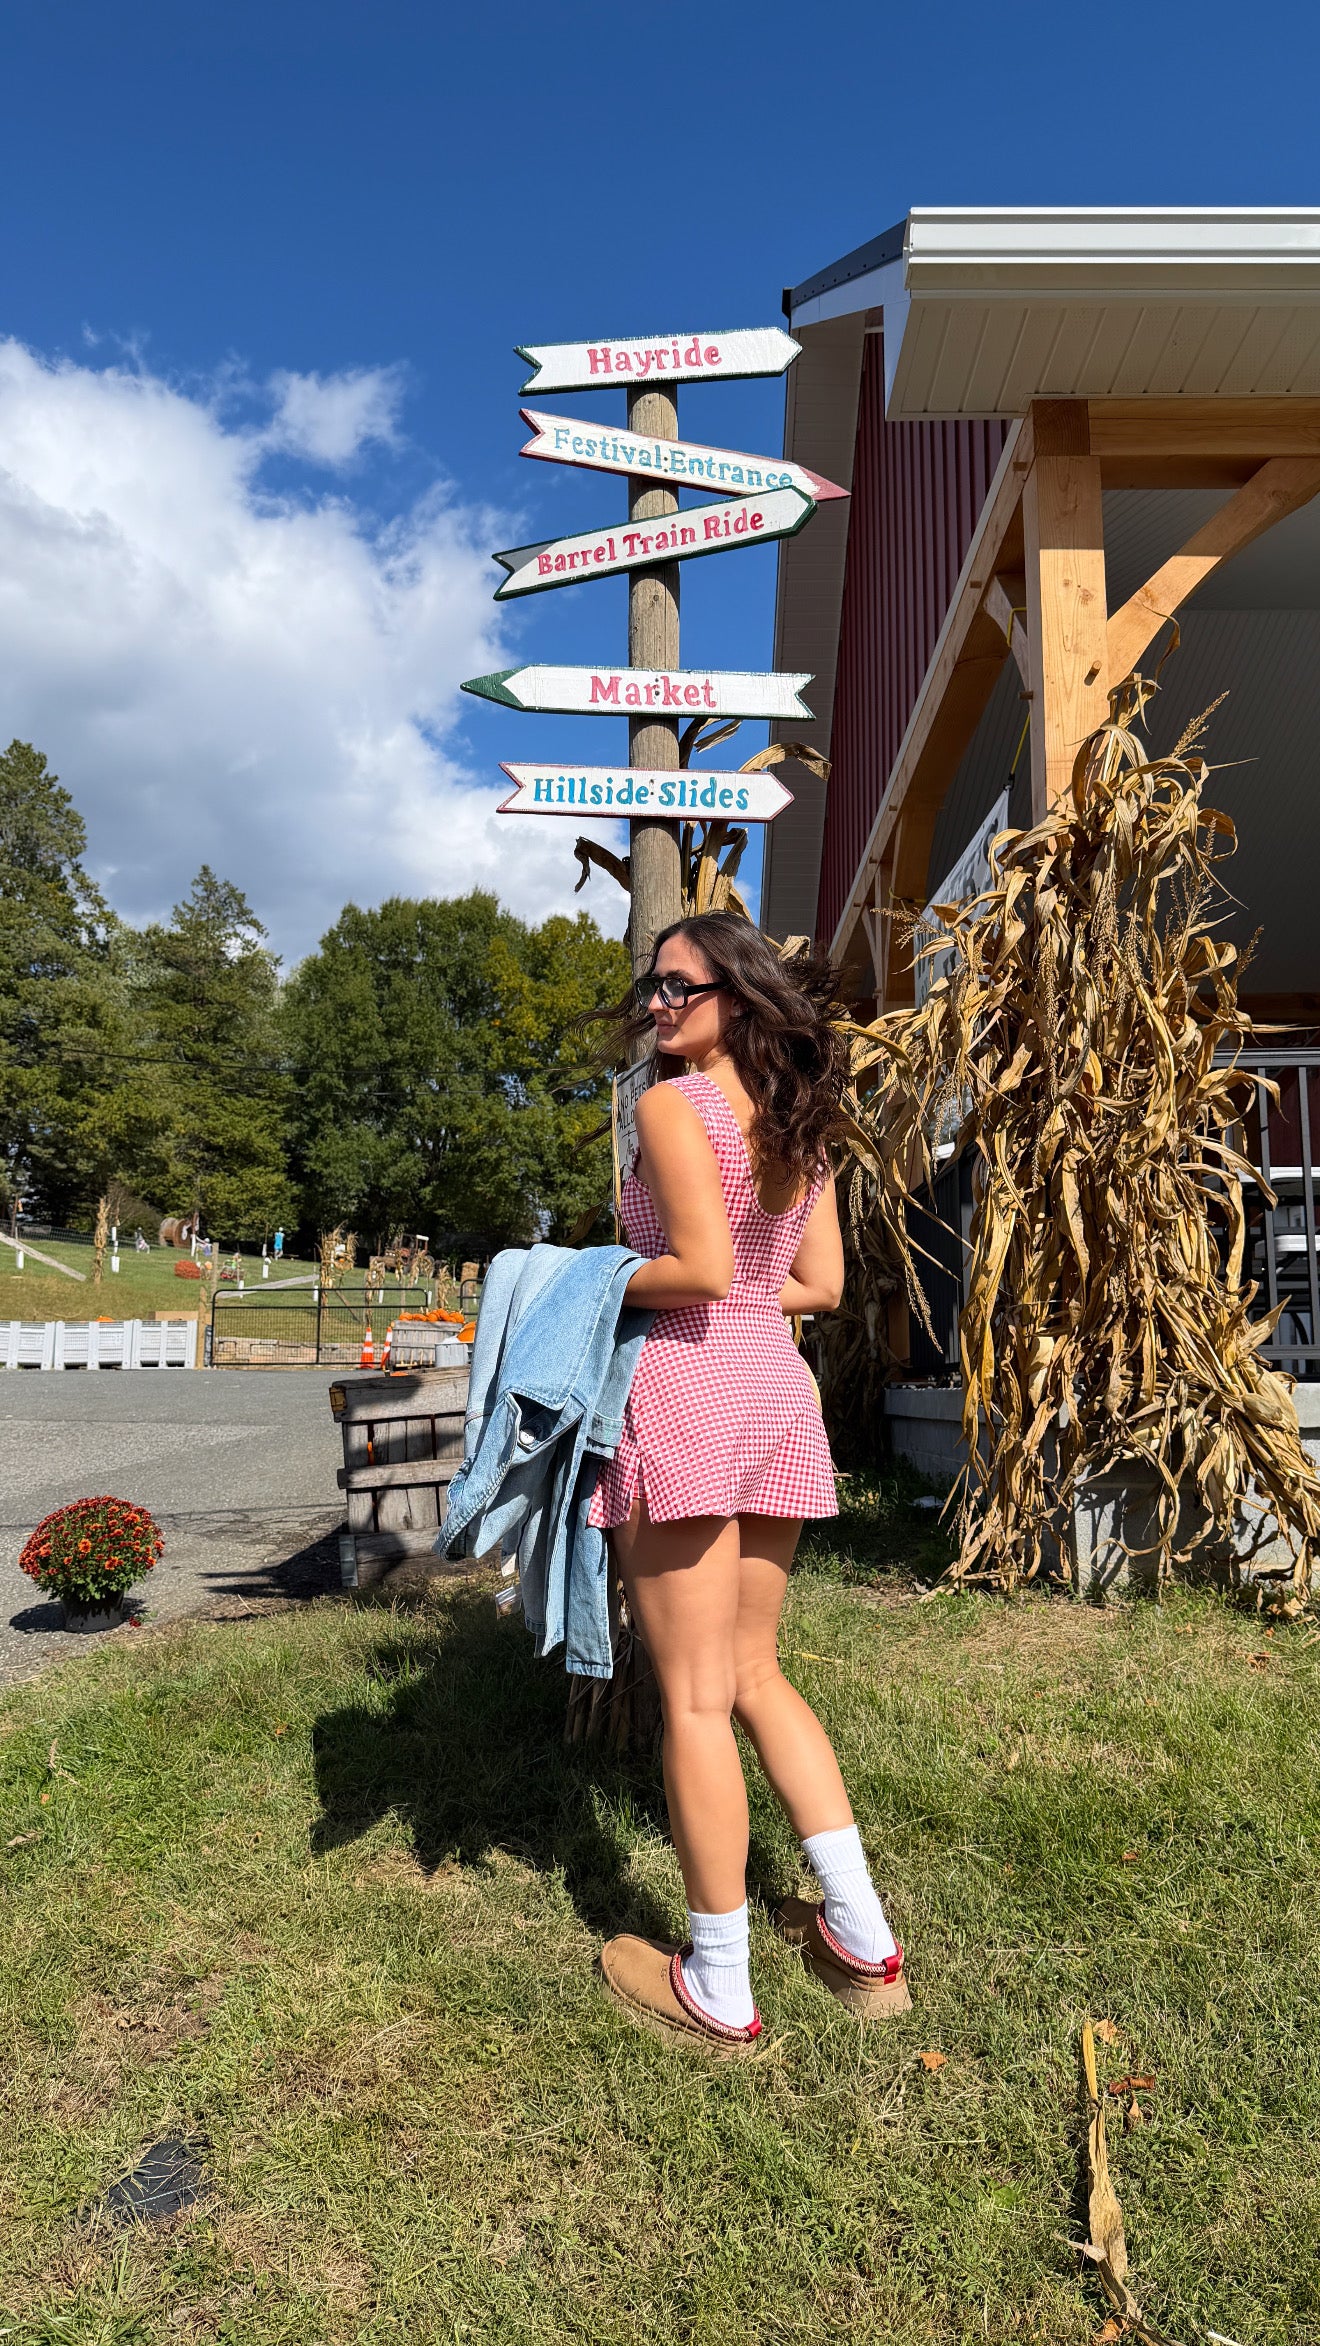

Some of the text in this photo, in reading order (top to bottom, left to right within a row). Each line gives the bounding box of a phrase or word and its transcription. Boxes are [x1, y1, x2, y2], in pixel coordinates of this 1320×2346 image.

[587, 337, 722, 377] Hayride
[554, 428, 793, 489] Festival Entrance
[536, 507, 765, 577] Barrel Train Ride
[588, 675, 718, 708] Market
[533, 776, 750, 811] Hillside Slides
[619, 1110, 635, 1131] ALLO
